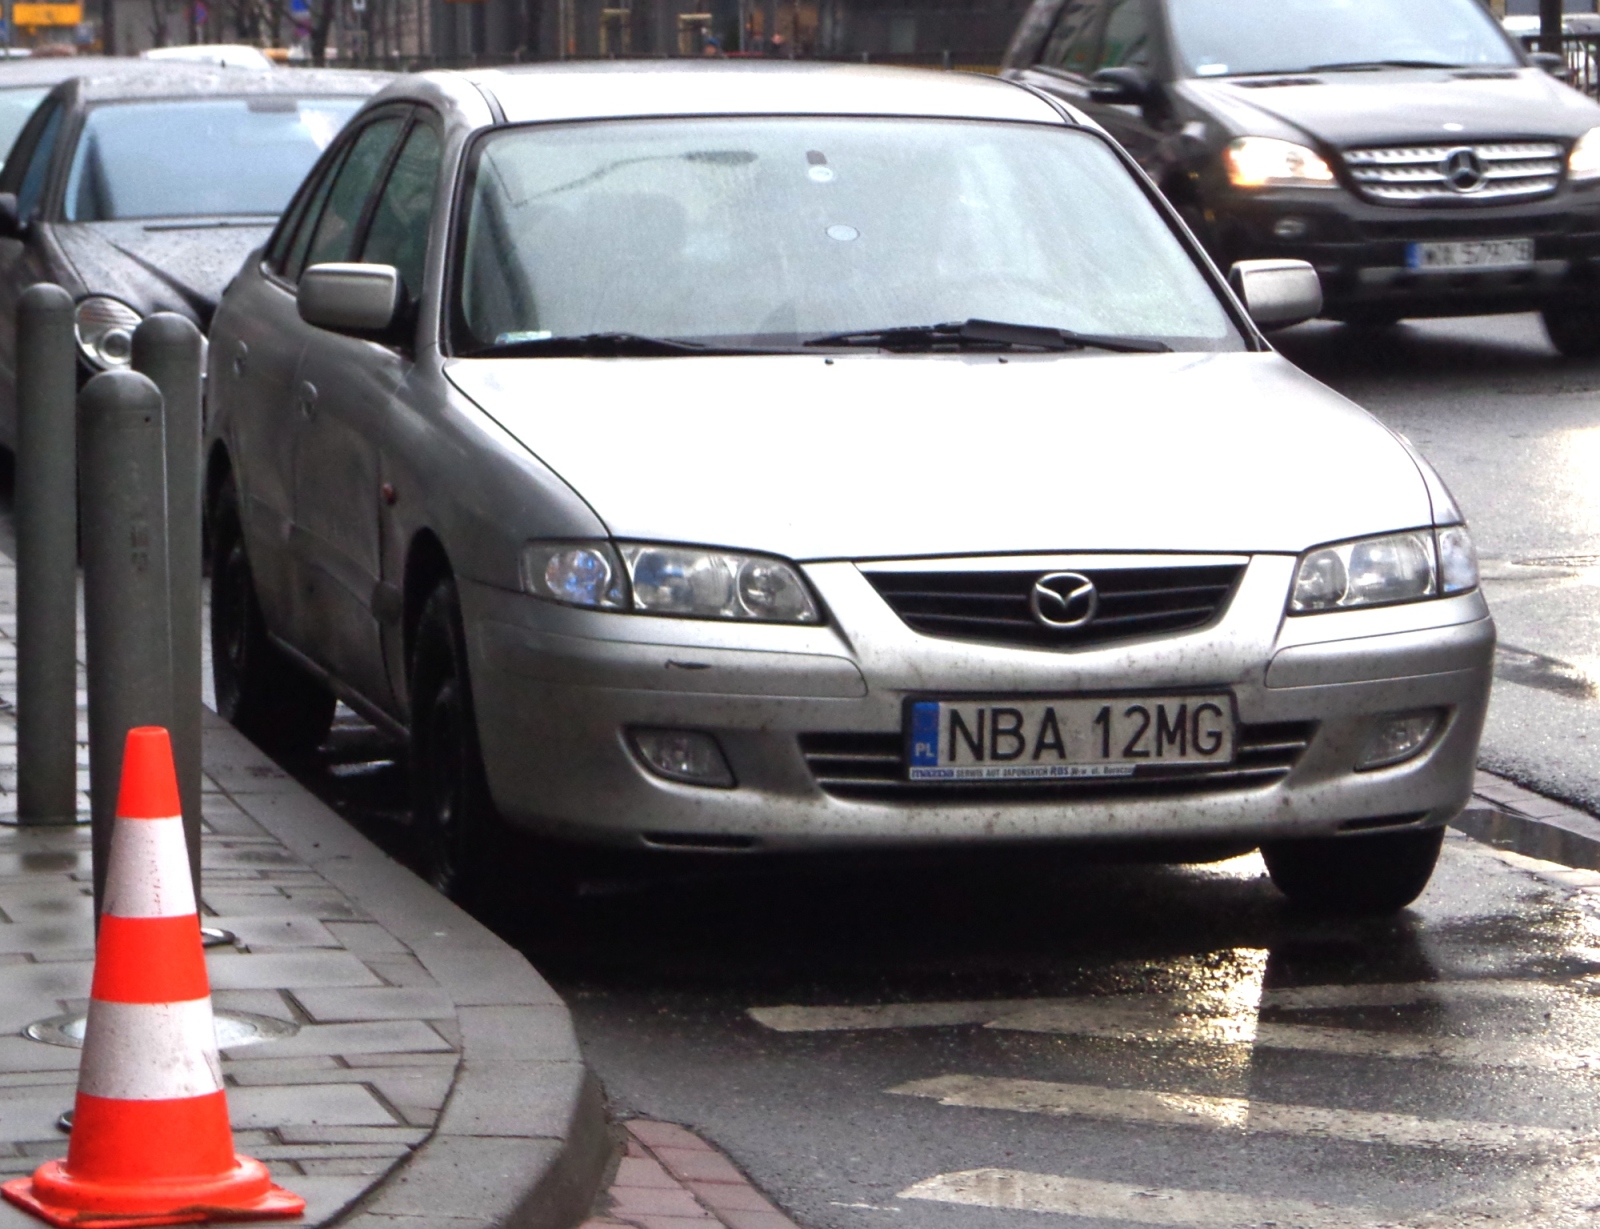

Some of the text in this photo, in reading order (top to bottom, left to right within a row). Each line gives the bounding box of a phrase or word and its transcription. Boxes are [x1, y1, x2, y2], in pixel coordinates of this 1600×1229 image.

[915, 742, 935, 757] PL
[949, 703, 1223, 761] NBA 12MG
